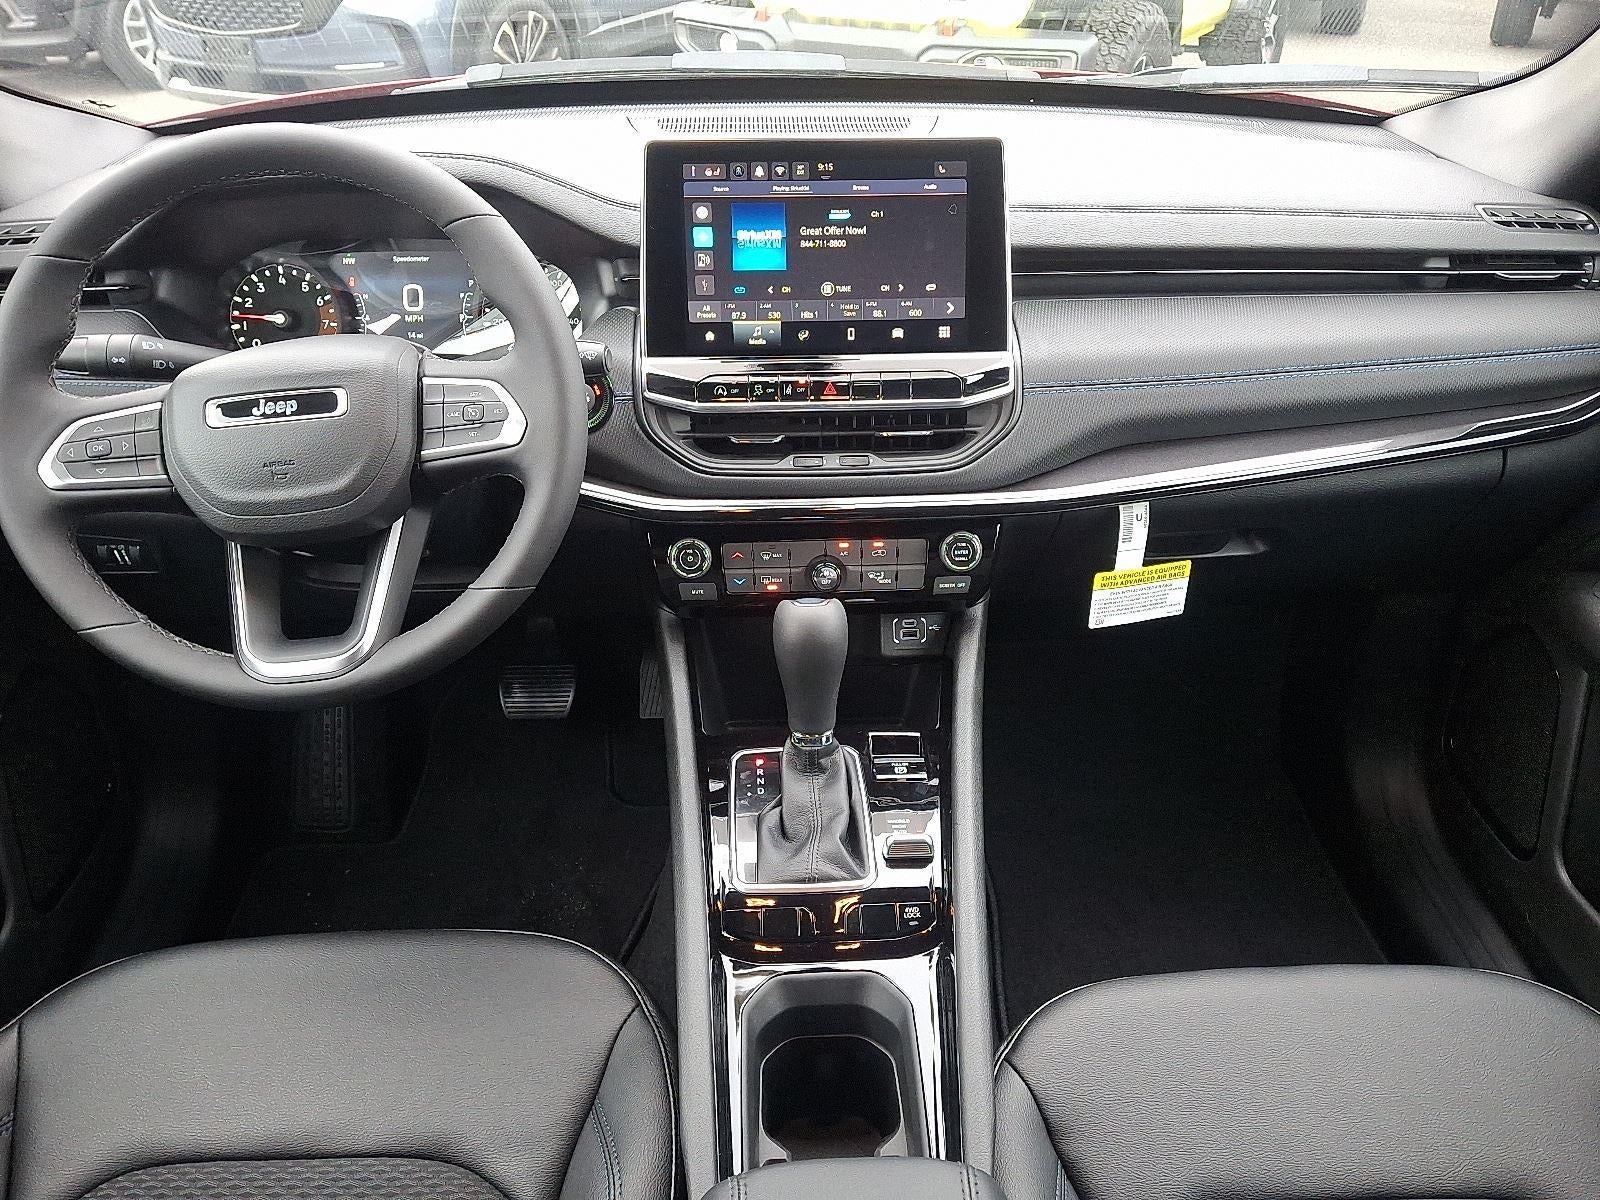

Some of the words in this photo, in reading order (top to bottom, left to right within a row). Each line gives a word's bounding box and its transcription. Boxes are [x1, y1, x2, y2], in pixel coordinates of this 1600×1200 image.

[816, 162, 834, 171] 9:15
[800, 226, 823, 236] Great
[823, 225, 845, 236] Offer
[392, 255, 430, 263] Speedometer
[278, 274, 287, 286] 4
[256, 282, 266, 293] 3
[301, 281, 310, 293] 5
[781, 286, 792, 294] CH
[835, 285, 852, 293] TUNE
[880, 284, 891, 292] CH
[316, 295, 324, 307] 6
[402, 283, 424, 312] 0
[244, 297, 254, 308] 2
[731, 311, 747, 320] 87.9
[767, 311, 781, 320] 530
[908, 308, 923, 317] 600
[404, 314, 424, 323] MPH
[321, 319, 330, 330] 7
[251, 398, 298, 417] Jeep
[92, 443, 104, 452] OK
[262, 459, 296, 469] AIRBAG
[1119, 571, 1145, 580] VEHICLE
[1154, 565, 1187, 574] EQUIPPED
[1100, 580, 1119, 588] WITH
[1119, 576, 1156, 586] ADVANCED
[1156, 572, 1168, 581] AIR
[1168, 570, 1186, 579] BAGS
[756, 768, 764, 776] R
[756, 777, 765, 785] N
[757, 787, 765, 795] D
